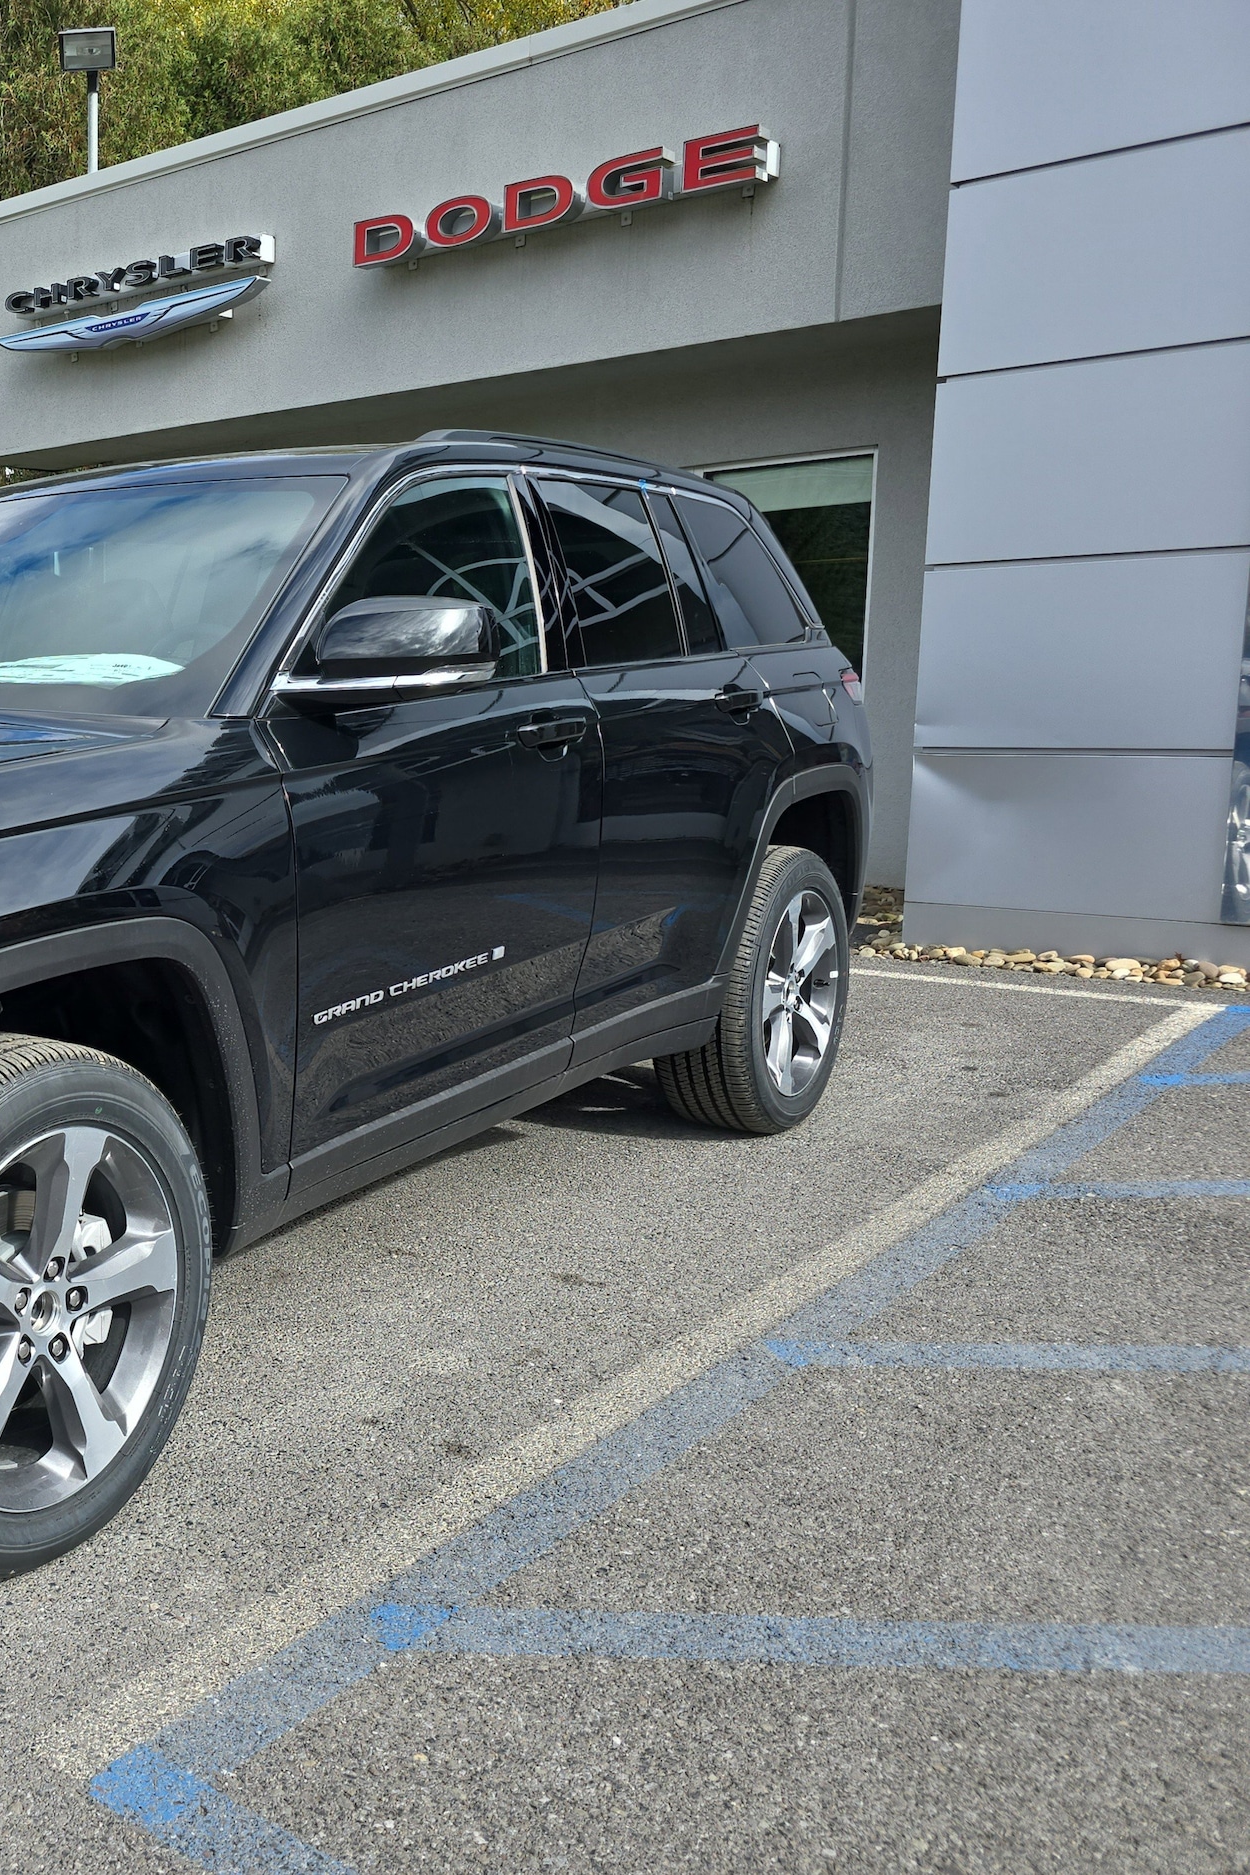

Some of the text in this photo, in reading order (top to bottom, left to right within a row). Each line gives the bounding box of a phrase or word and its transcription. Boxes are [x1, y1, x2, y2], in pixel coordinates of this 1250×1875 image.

[353, 123, 766, 269] DODGE
[4, 234, 262, 315] CHRYSLER
[91, 315, 142, 332] CHRYSLER
[312, 951, 489, 1026] GRAND CHEROKEE
